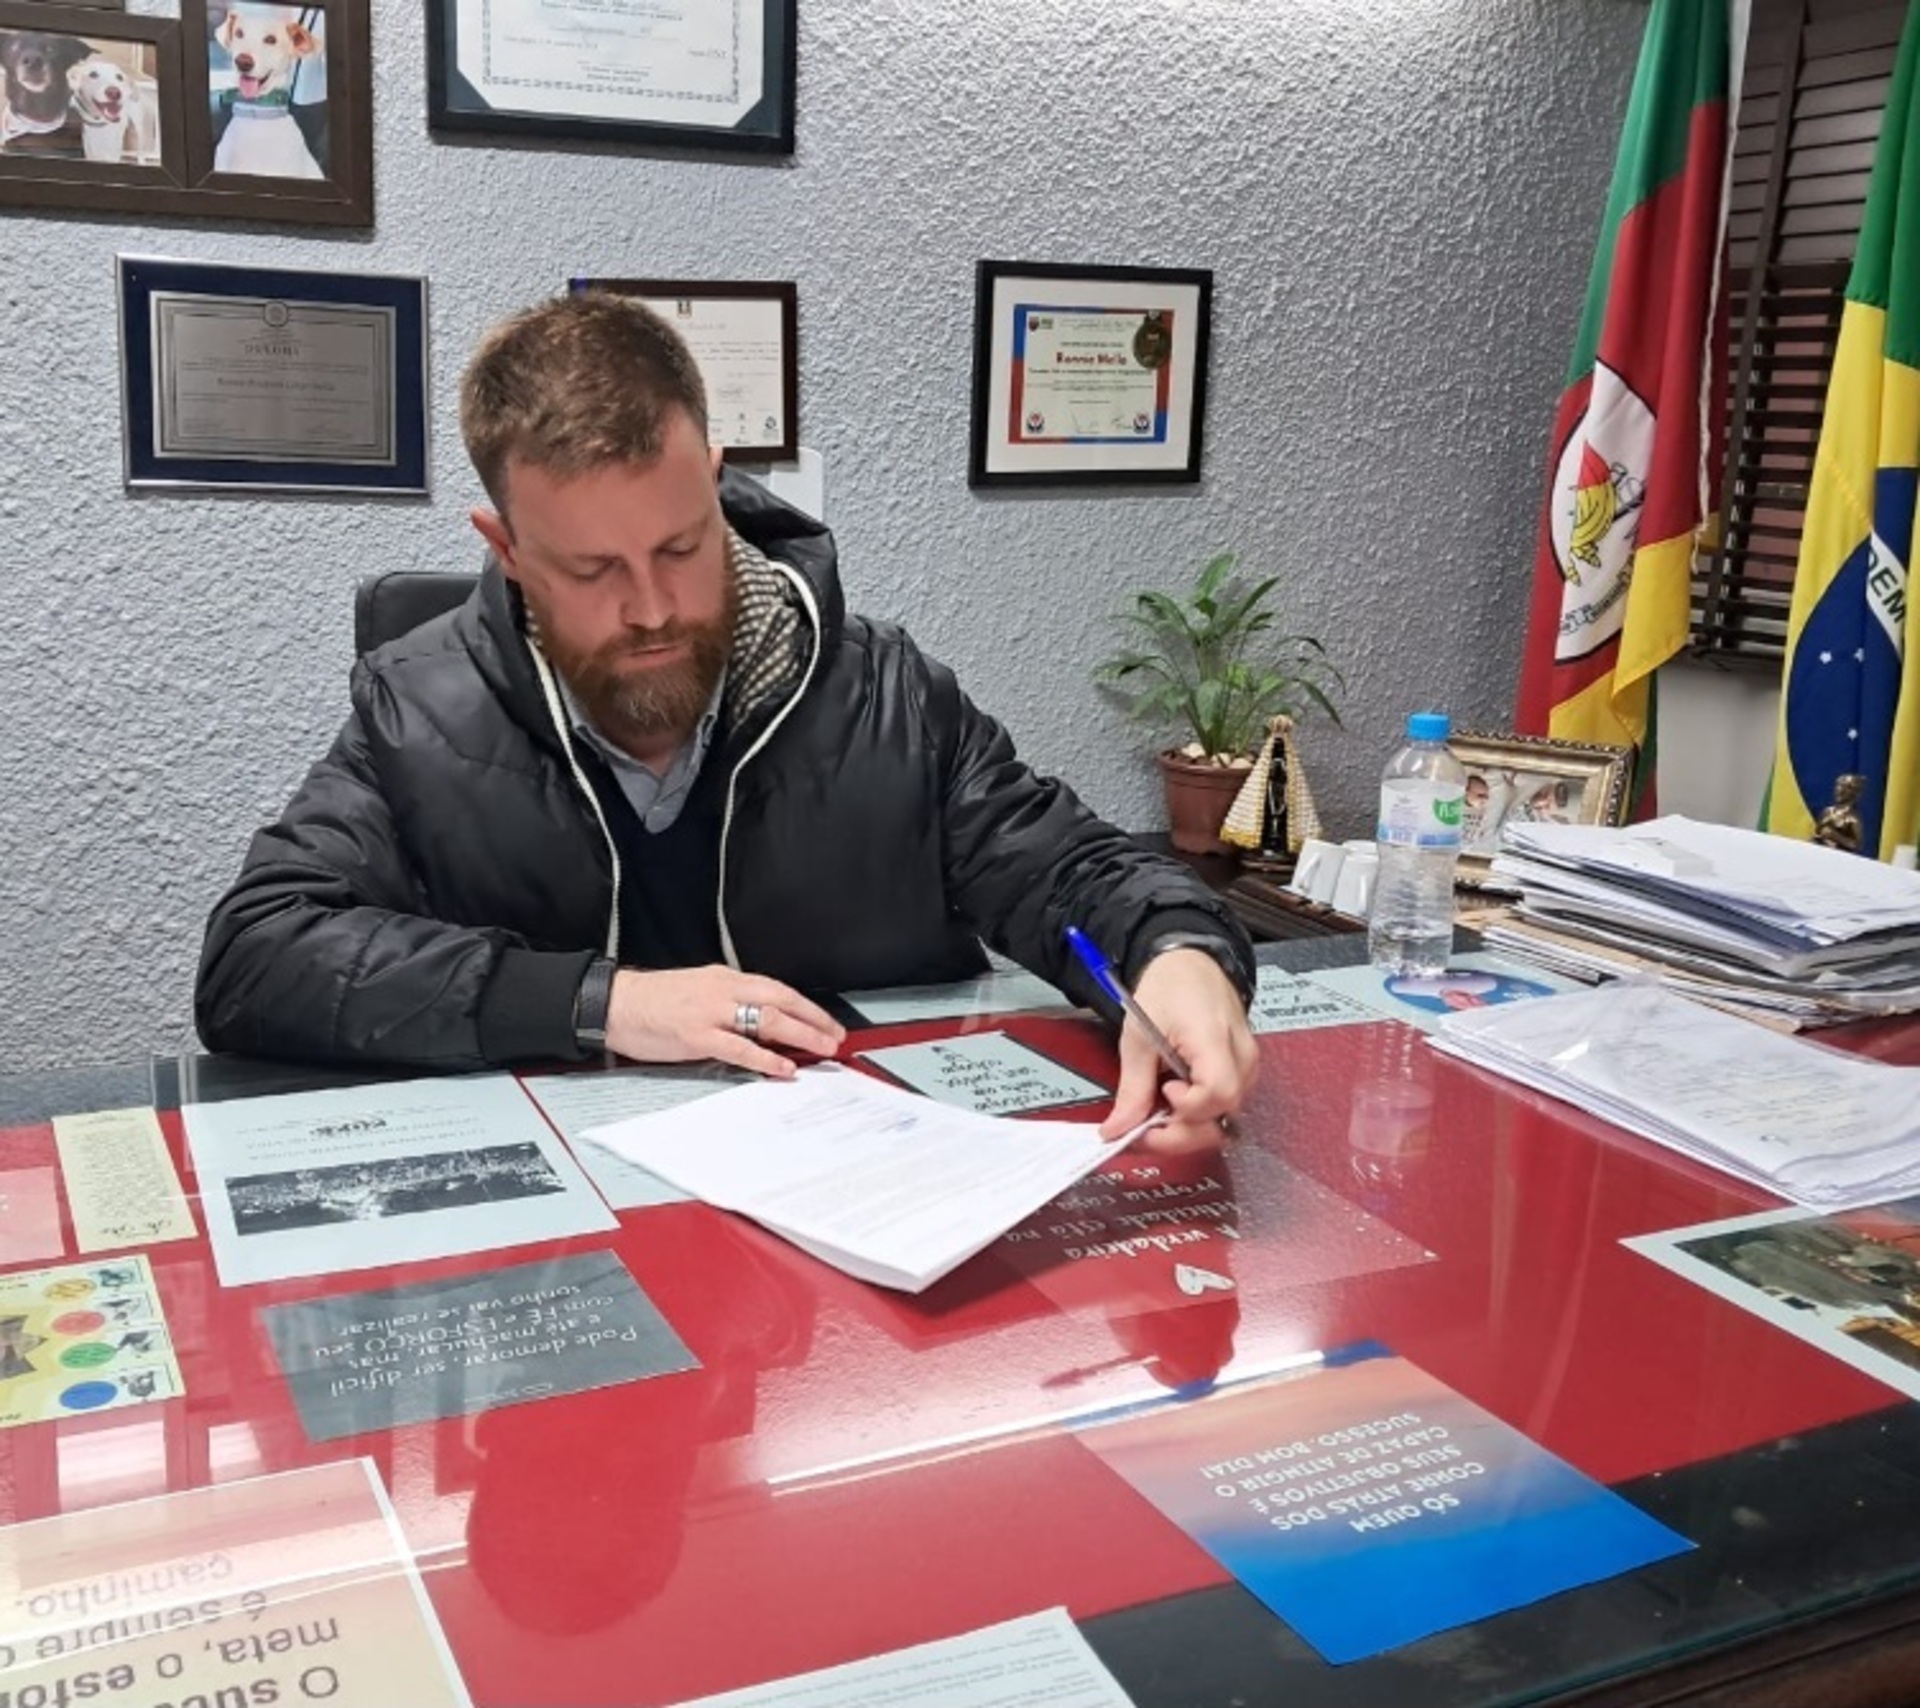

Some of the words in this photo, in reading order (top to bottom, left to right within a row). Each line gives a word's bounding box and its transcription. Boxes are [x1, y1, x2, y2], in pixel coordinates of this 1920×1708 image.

[1216, 1222, 1241, 1239] A
[1064, 1229, 1210, 1259] verdadeira
[469, 1297, 503, 1312] vai
[510, 1284, 581, 1308] sonho
[563, 1295, 613, 1312] com
[438, 1306, 461, 1319] se
[504, 1313, 517, 1323] e
[588, 1315, 601, 1324] e
[365, 1319, 496, 1353] ESFORÇO
[546, 1318, 579, 1337] até
[575, 1326, 637, 1348] Pode
[315, 1342, 354, 1357] seu
[349, 1353, 399, 1369] mas
[411, 1360, 446, 1376] ser
[1375, 1426, 1449, 1454] CAPAZ
[1257, 1440, 1312, 1465] BOM
[1338, 1446, 1372, 1464] DE
[1409, 1445, 1461, 1469] SEUS
[1199, 1457, 1255, 1480] DIA!
[1238, 1455, 1336, 1492] ATINGIR
[1404, 1462, 1485, 1493] CORRE
[1215, 1484, 1237, 1498] O
[1268, 1462, 1402, 1508] OBJETIVOS
[1249, 1498, 1268, 1515] É
[1326, 1483, 1402, 1515] ATRÁS
[1423, 1492, 1460, 1514] SÓ
[1270, 1506, 1327, 1531] DOS
[1350, 1505, 1421, 1533] QUEM
[242, 1590, 267, 1621] é
[36, 1600, 223, 1659] sempre
[204, 1617, 339, 1664] meta,
[156, 1654, 183, 1679] o
[299, 1666, 339, 1698] O
